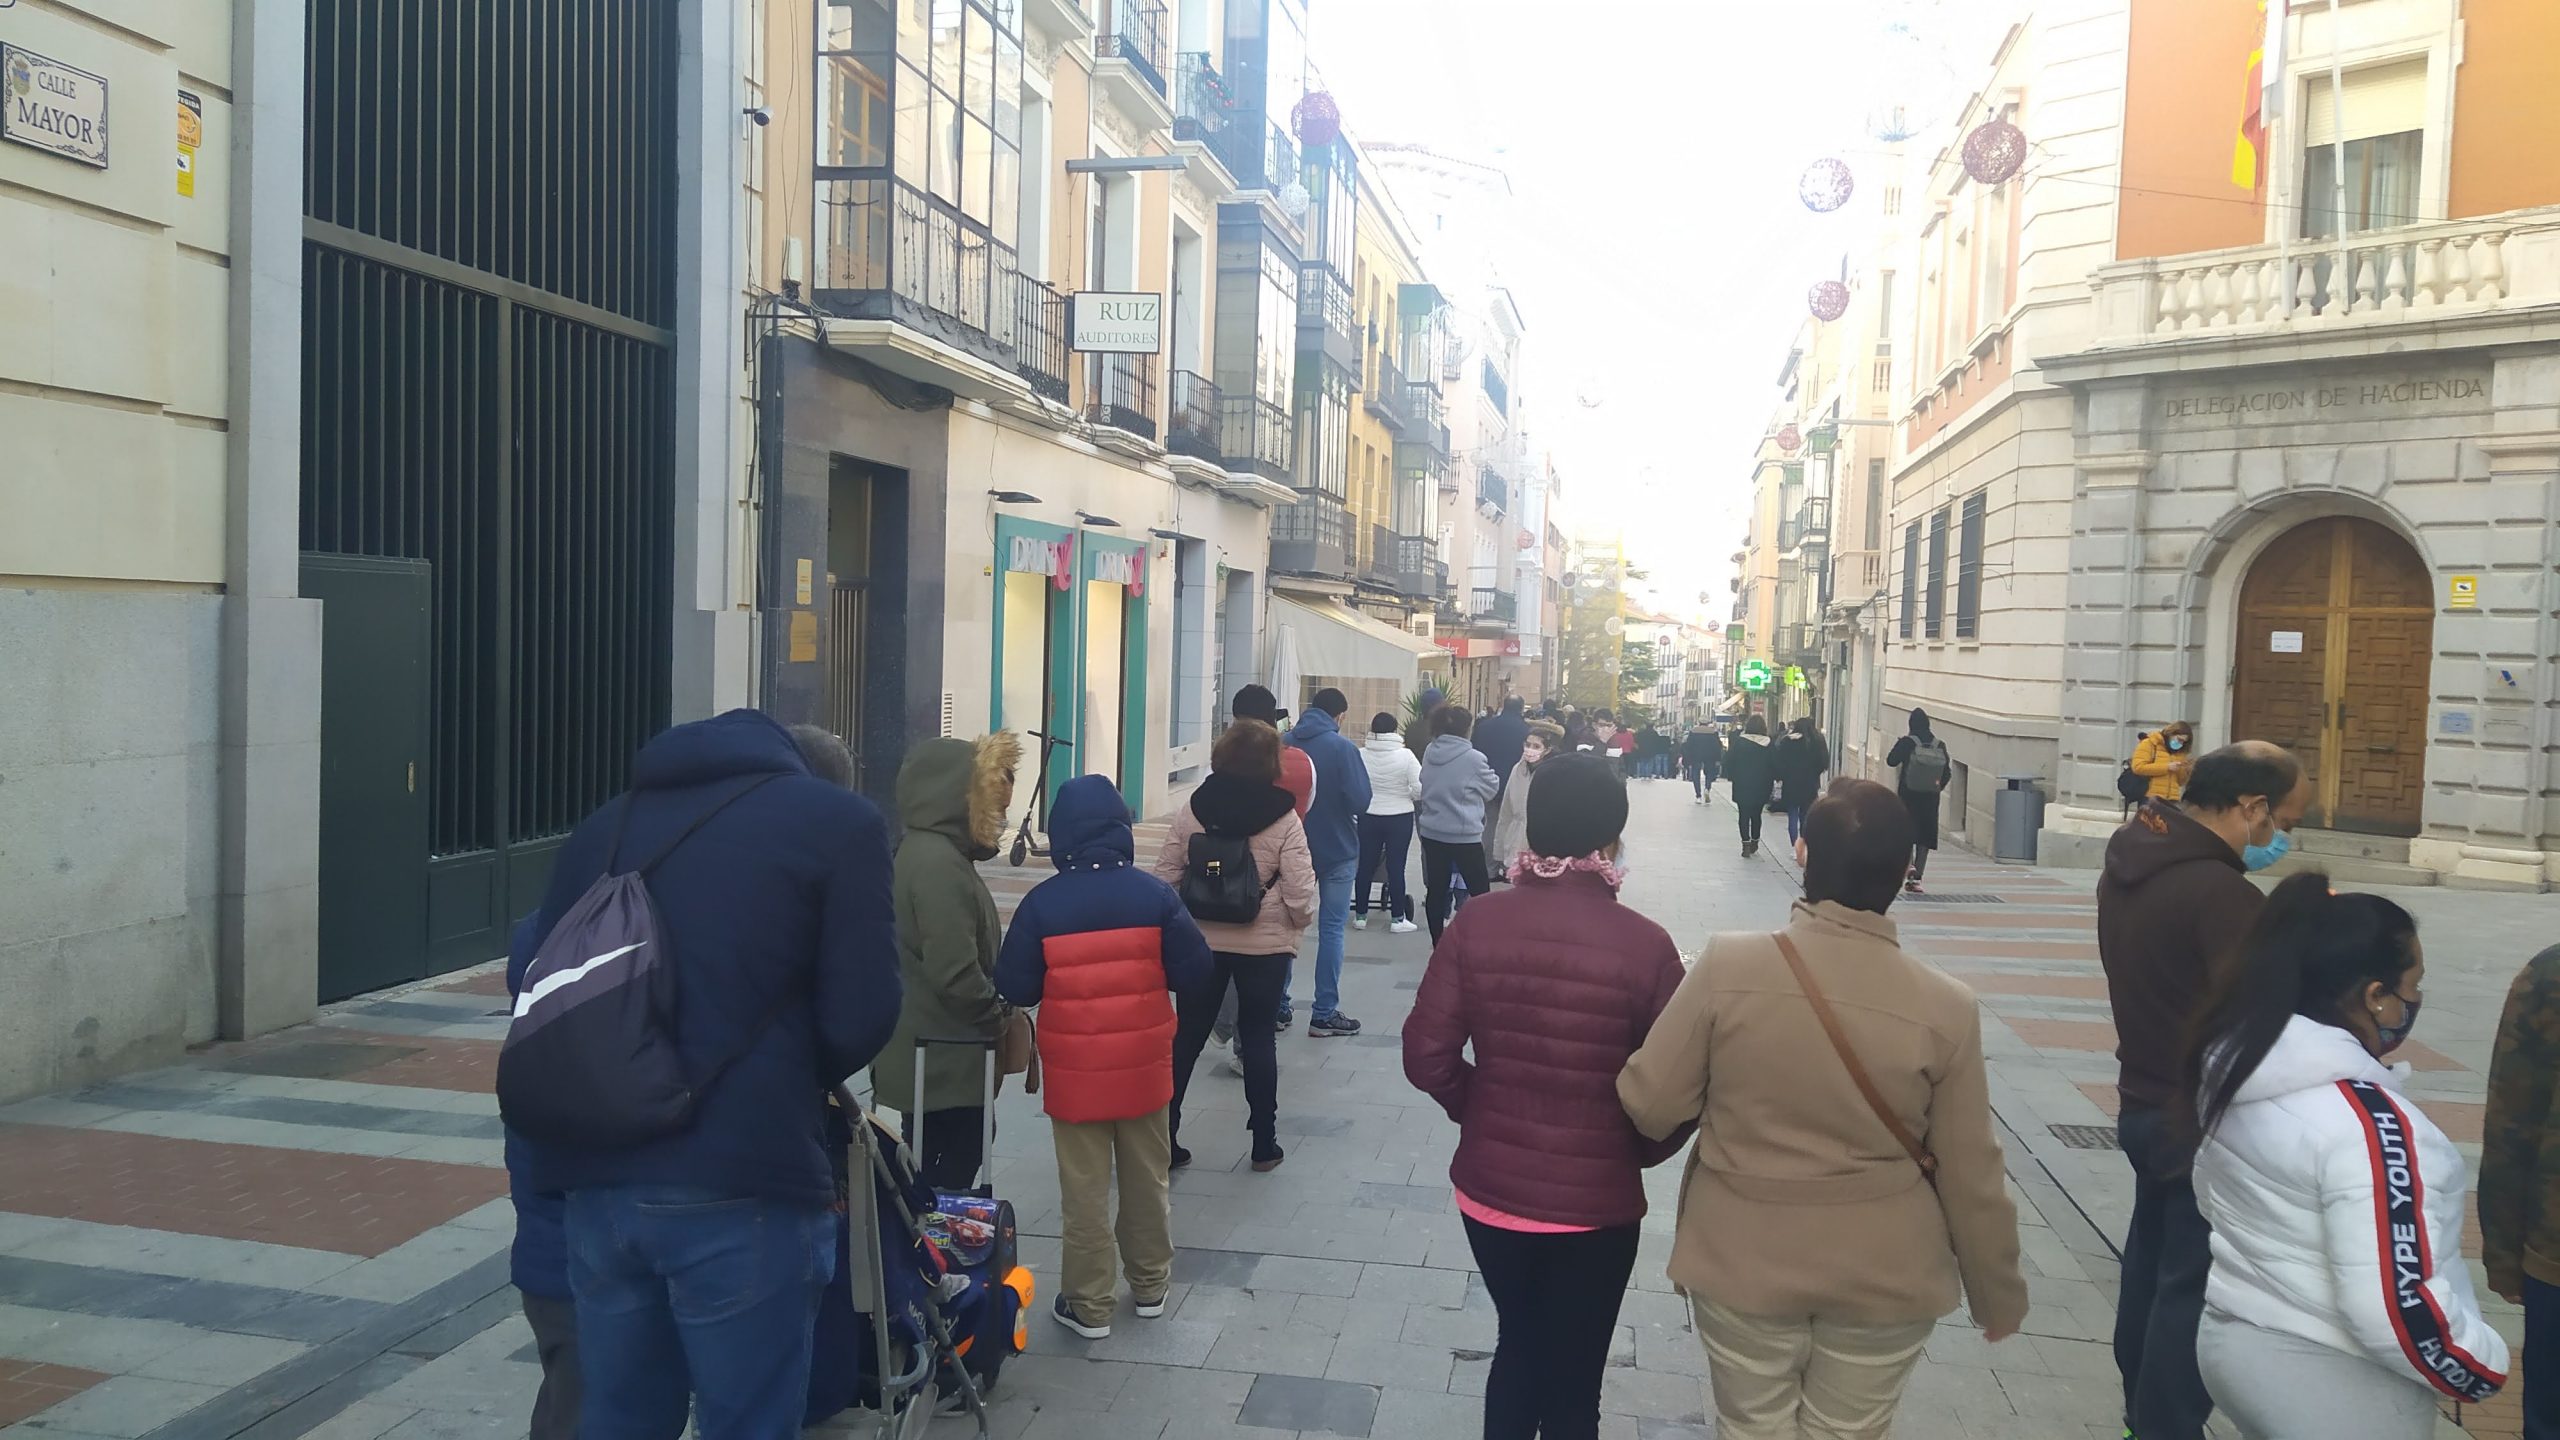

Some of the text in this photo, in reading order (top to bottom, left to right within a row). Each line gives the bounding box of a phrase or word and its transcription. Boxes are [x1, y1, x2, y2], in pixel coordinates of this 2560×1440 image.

[37, 71, 76, 99] CALLE
[18, 96, 93, 144] MAYOR
[1099, 302, 1157, 321] RUIZ
[1077, 331, 1157, 344] AUDITORES
[2165, 378, 2485, 418] DELEGACION DE HACIENDA
[2373, 1112, 2423, 1309] HYPE YOUTH
[2417, 1336, 2476, 1393] YOUTH
